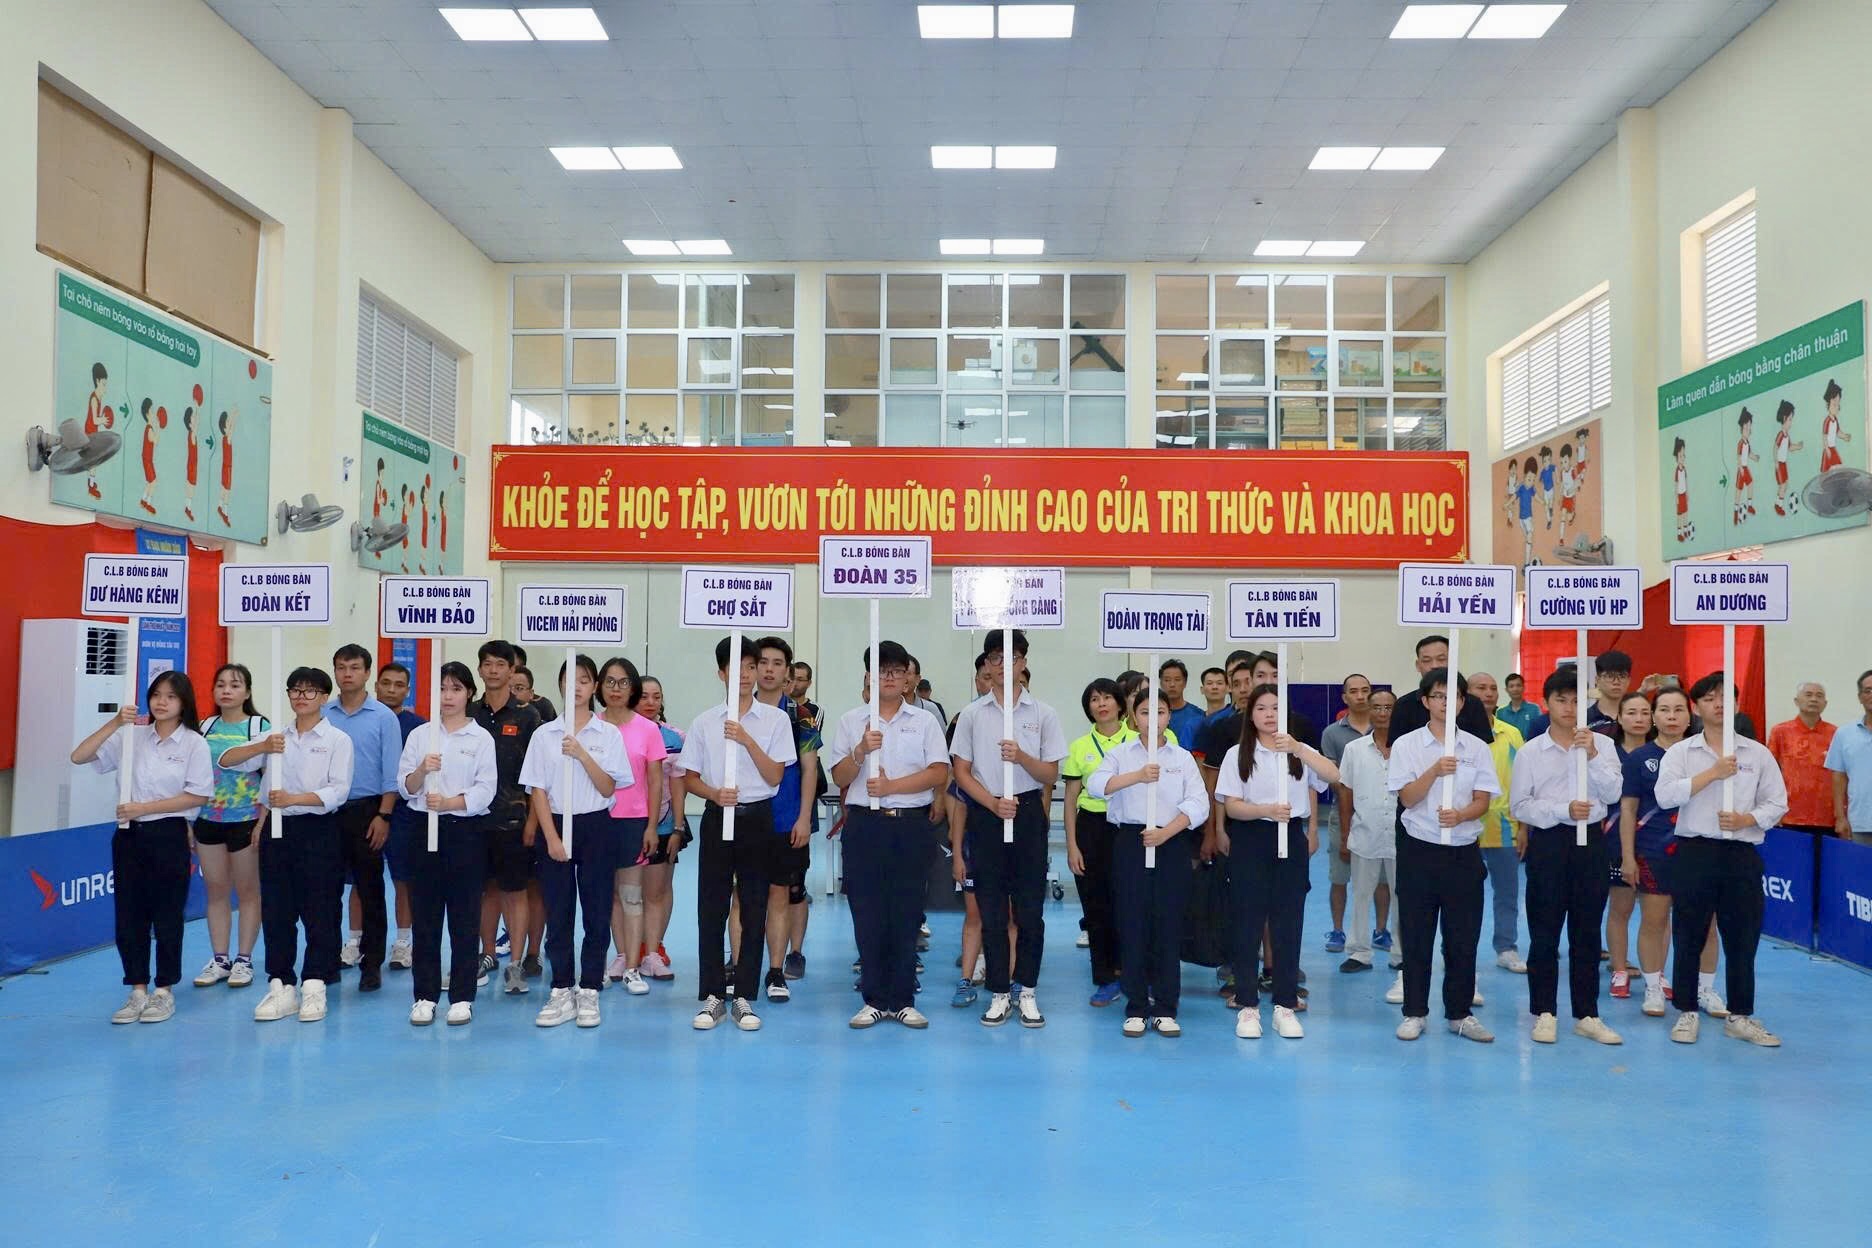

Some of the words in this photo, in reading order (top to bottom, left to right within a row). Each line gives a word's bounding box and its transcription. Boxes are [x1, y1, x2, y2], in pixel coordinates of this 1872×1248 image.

[63, 283, 75, 303] Tại
[112, 308, 132, 331] bóng
[175, 338, 187, 353] hai
[187, 343, 197, 360] tay
[1666, 395, 1683, 411] Làm
[1685, 386, 1707, 407] quen
[1728, 368, 1753, 387] bóng
[1755, 356, 1781, 377] bằng
[1784, 343, 1811, 366] chân
[1814, 328, 1848, 353] thuận
[503, 471, 569, 529] KHỎE
[577, 468, 613, 529] ĐỂ
[618, 486, 670, 539] HỌC
[678, 477, 729, 539] TẬP,
[738, 483, 808, 531] VƯƠN
[815, 478, 856, 531] TỚI
[864, 479, 956, 532] NHỮNG
[964, 474, 1027, 532] ĐỈNH
[1036, 489, 1088, 533] CAO
[1097, 475, 1149, 533] CỦA
[1157, 490, 1197, 534] TRI
[1206, 481, 1273, 534] THỨC
[1282, 482, 1316, 535] VÀ
[1324, 491, 1394, 535] KHOA
[1402, 492, 1454, 546] HỌC
[842, 548, 862, 557] C.L.B
[866, 546, 889, 558] BÓNG
[892, 546, 910, 558] BÀN
[103, 566, 124, 576] C.L.B
[126, 565, 149, 577] BÓNG
[151, 565, 168, 577] BÀN
[242, 575, 263, 585] C.L.B
[266, 573, 290, 585] BÓNG
[293, 572, 310, 584] BÀN
[834, 565, 887, 584] ĐOÀN
[894, 569, 917, 584] 35
[1422, 576, 1444, 586] C.L.B
[1447, 575, 1472, 586] BÓNG
[1475, 575, 1494, 587] BÀN
[1694, 574, 1717, 583] C.L.B
[1720, 571, 1746, 583] BÓNG
[1749, 571, 1768, 583] BÀN
[403, 587, 424, 597] C.L.B
[427, 586, 450, 597] BÓNG
[453, 586, 470, 597] BÀN
[704, 579, 724, 589] C.L.B
[728, 578, 751, 590] BÓNG
[754, 579, 772, 590] BÀN
[1548, 578, 1570, 588] C.L.B
[1573, 576, 1598, 588] BÓNG
[1601, 576, 1620, 588] BÀN
[90, 585, 108, 602] DƯ
[110, 583, 143, 603] HÀNG
[146, 585, 179, 605] KÊNH
[242, 593, 280, 612] ĐOÀN
[285, 591, 311, 611] KẾT
[539, 596, 559, 605] C.L.B
[563, 594, 583, 606] BÓNG
[586, 594, 606, 606] BÀN
[1248, 591, 1269, 601] C.L.B
[1273, 589, 1296, 601] BÓNG
[1299, 589, 1317, 601] BÀN
[1419, 592, 1450, 613] HẢI
[1458, 593, 1495, 614] YẾN
[1696, 595, 1715, 610] AN
[1720, 593, 1766, 611] DƯƠNG
[398, 605, 436, 623] VĨNH
[442, 602, 474, 624] BẢO
[708, 598, 736, 619] CHỢ
[740, 596, 768, 617] SẮT
[1540, 596, 1585, 615] CƯỜNG
[1589, 596, 1606, 615] VŨ
[1611, 599, 1628, 615] HP
[527, 616, 559, 631] VICEM
[562, 609, 579, 631] HẢI
[583, 613, 617, 632] PHÒNG
[1107, 608, 1140, 630] ĐOÀN
[1144, 612, 1183, 634] TRỌNG
[1187, 609, 1204, 631] TÀI
[1245, 609, 1278, 627] TÂN
[1283, 606, 1320, 627] TIẾN
[62, 870, 114, 906] UNRE
[1846, 891, 1872, 924] TIB
